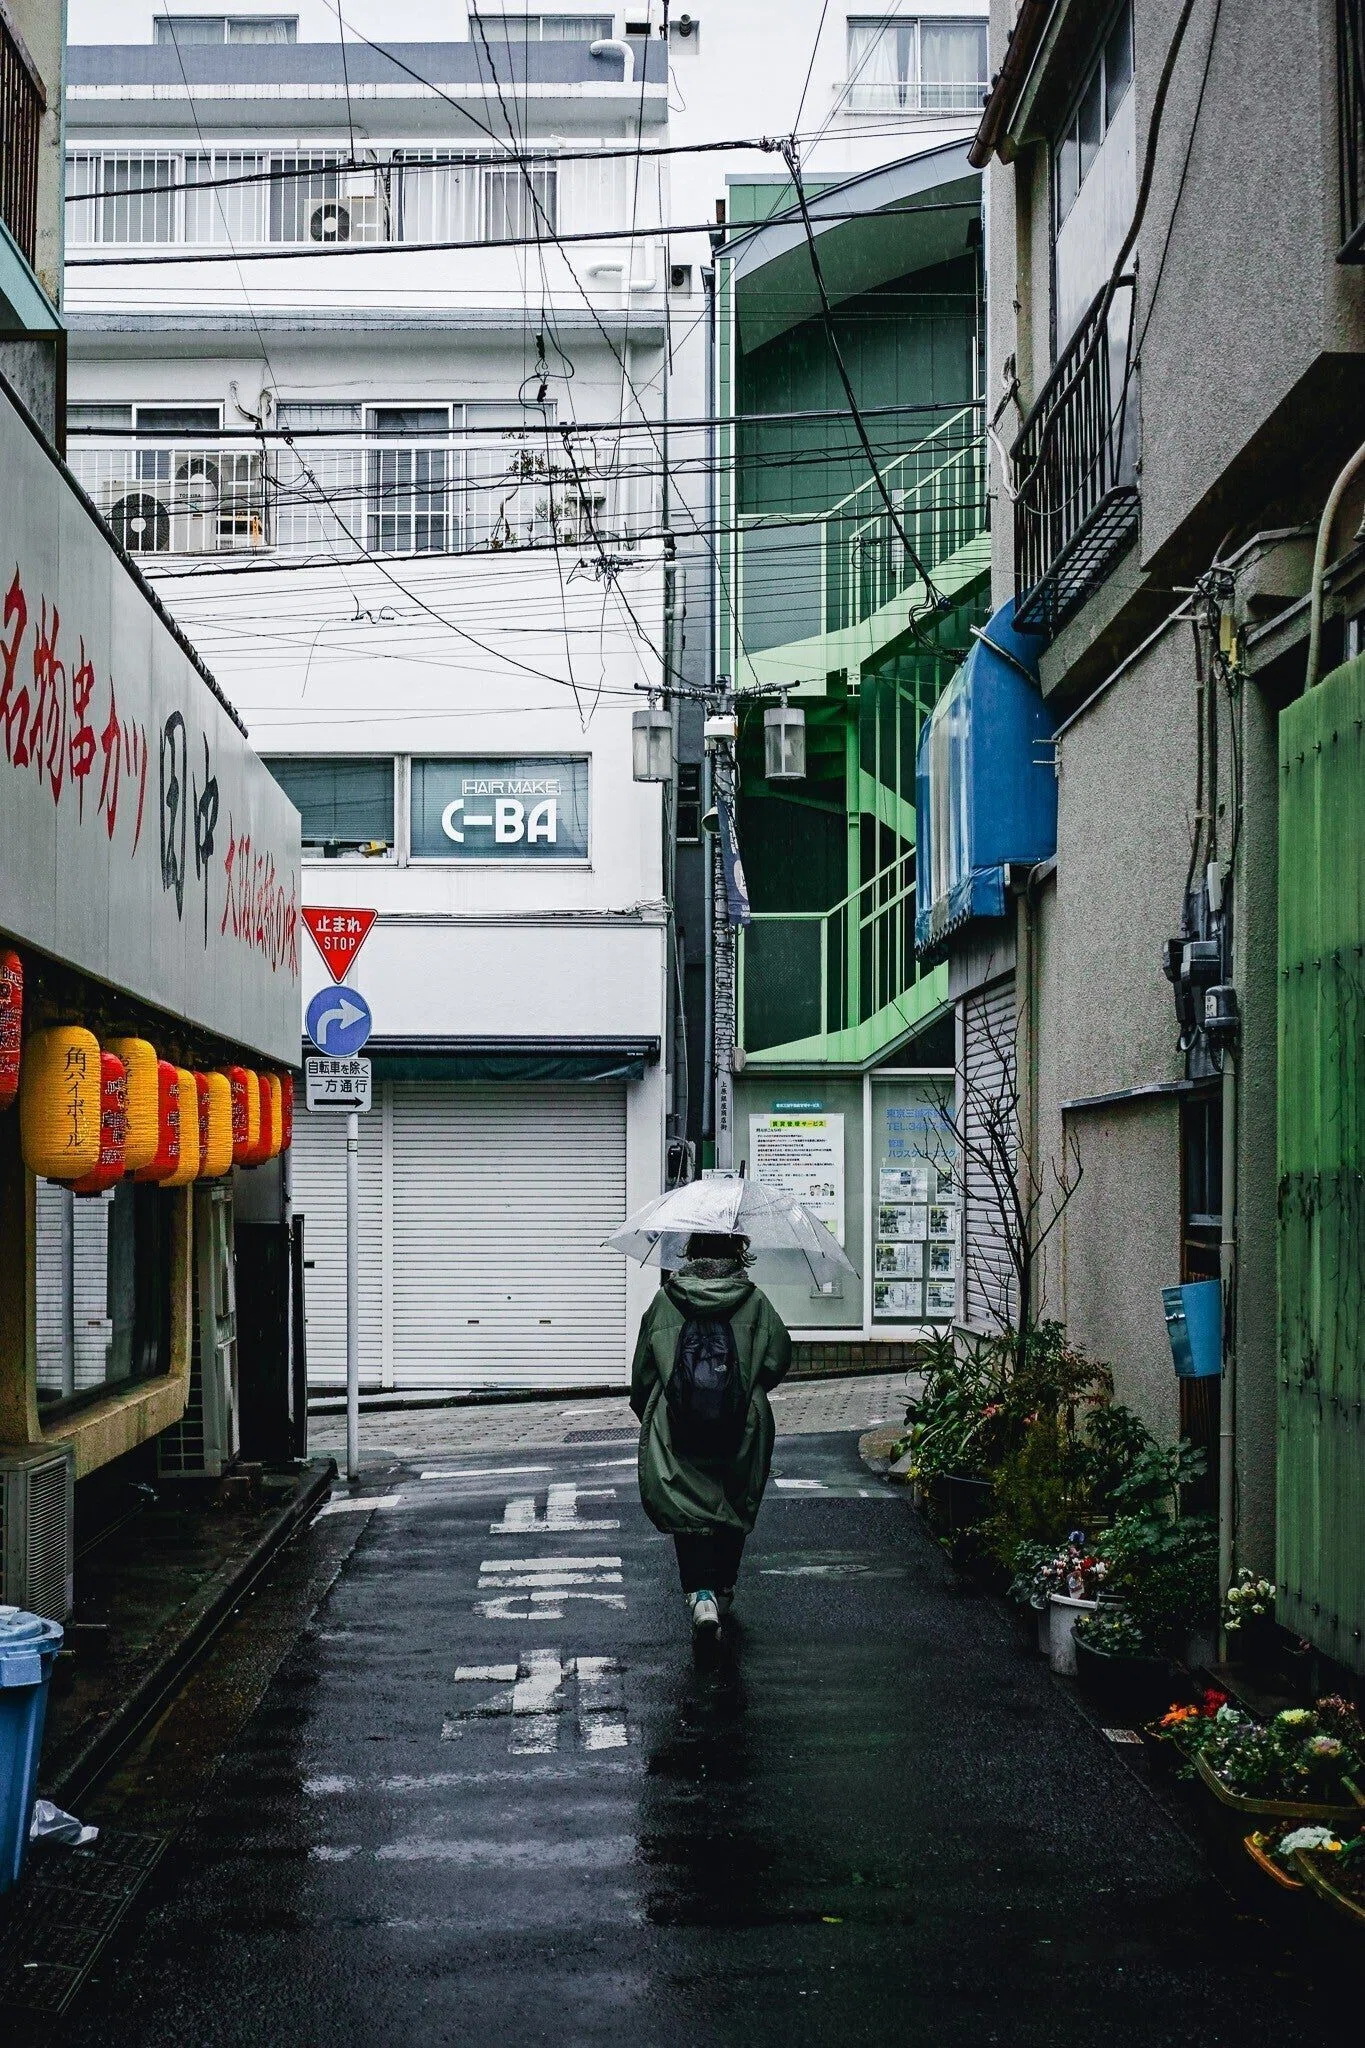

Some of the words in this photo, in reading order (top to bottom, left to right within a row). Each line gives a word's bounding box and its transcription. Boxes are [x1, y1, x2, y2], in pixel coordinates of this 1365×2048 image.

[464, 781, 504, 794] HAIR
[508, 781, 557, 794] MAKE
[441, 798, 557, 843] C-BA
[316, 915, 362, 932] 止まれ
[324, 936, 356, 951] STOP
[308, 1060, 369, 1075] 自転車を除く
[310, 1078, 368, 1093] 一方通行
[63, 1046, 87, 1150] 角ハイボール
